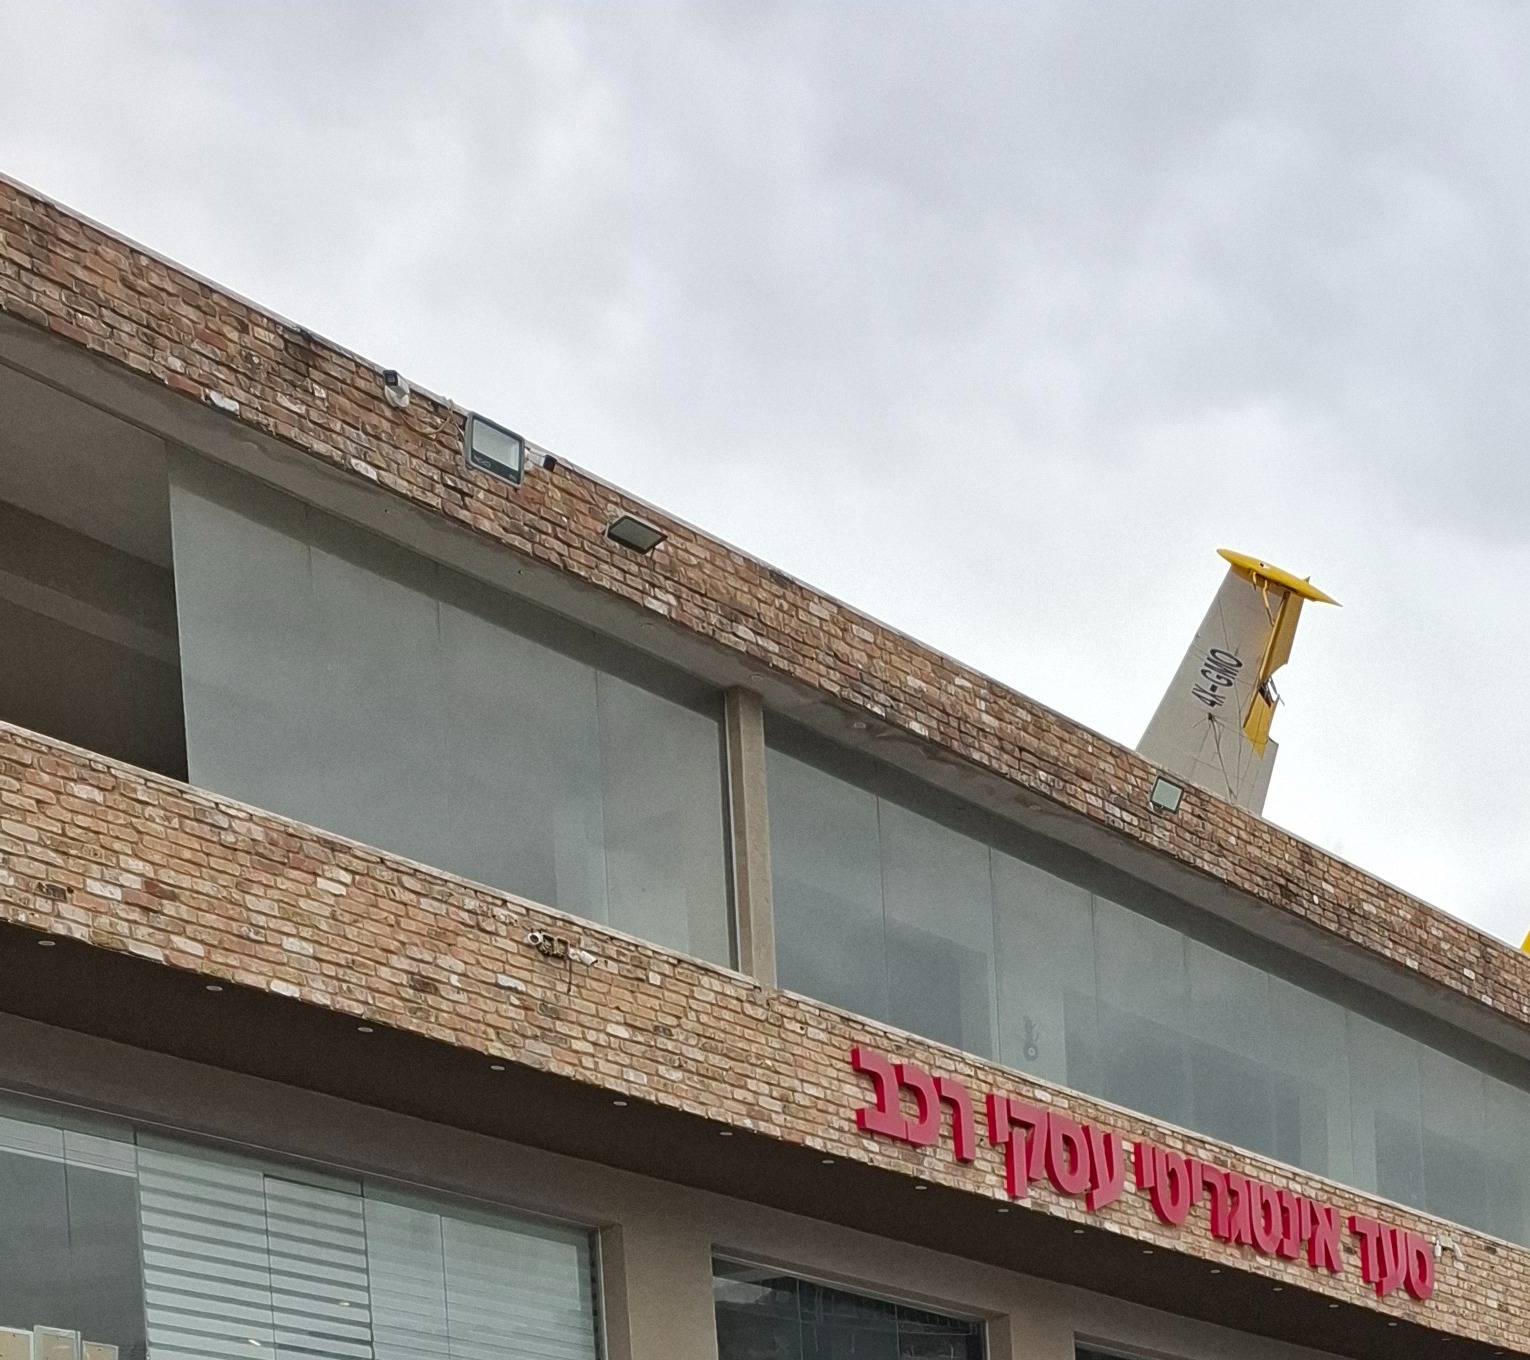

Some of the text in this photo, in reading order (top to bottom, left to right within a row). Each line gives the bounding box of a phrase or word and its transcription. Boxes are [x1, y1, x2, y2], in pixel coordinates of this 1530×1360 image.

[1191, 648, 1243, 708] 4X-GMO
[851, 1045, 1436, 1300] סעד אינטגריטי עסקי רכב
